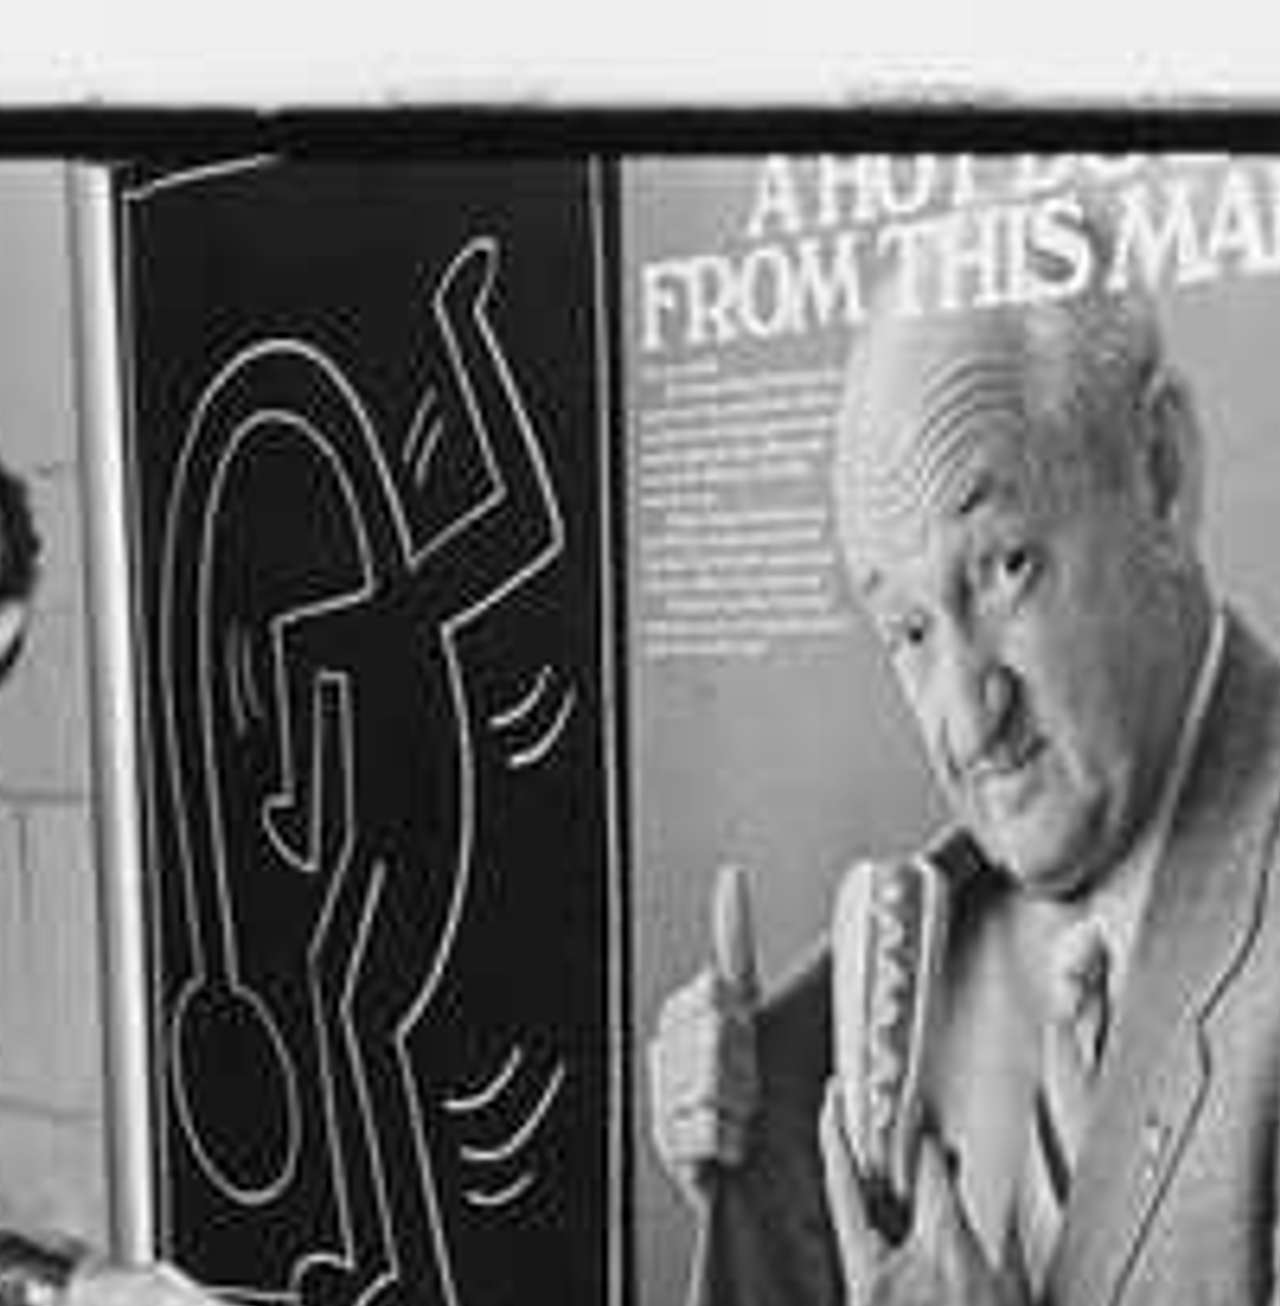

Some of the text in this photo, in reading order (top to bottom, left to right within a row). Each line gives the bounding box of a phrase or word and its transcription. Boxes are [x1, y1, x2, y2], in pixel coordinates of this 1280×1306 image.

[747, 153, 804, 238] A
[642, 236, 870, 350] FROM
[874, 190, 1092, 318] THIS
